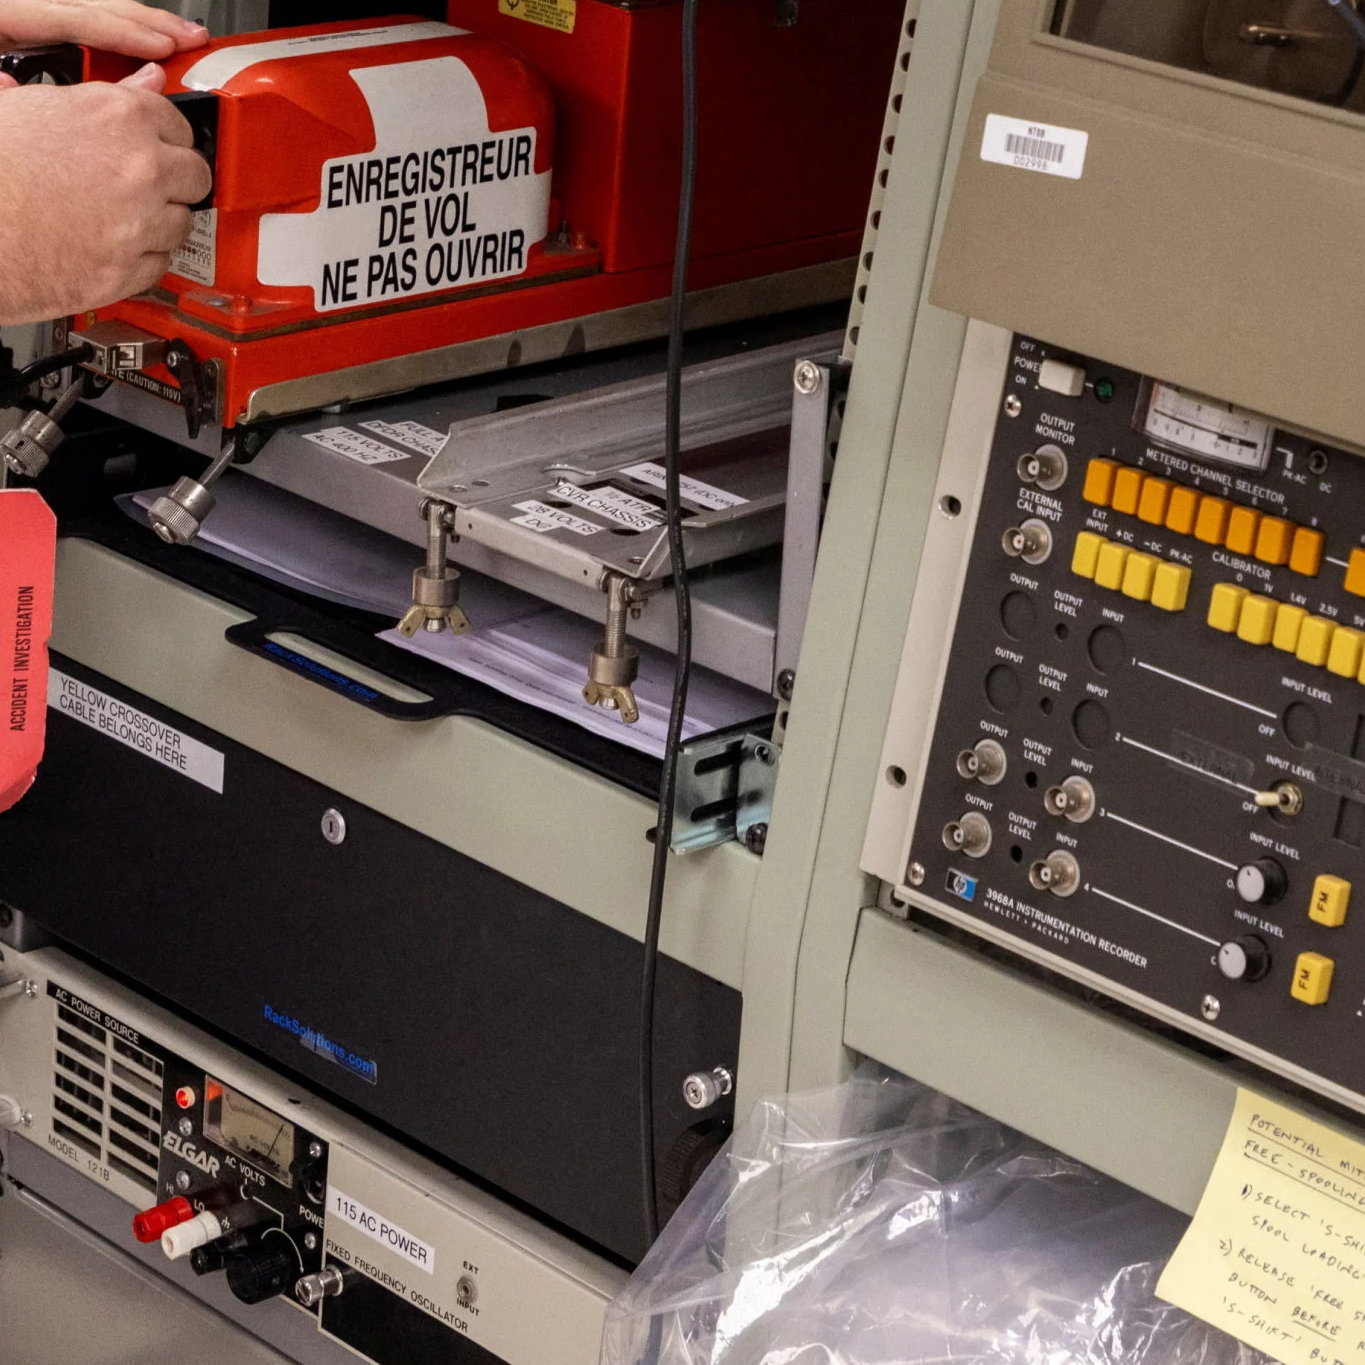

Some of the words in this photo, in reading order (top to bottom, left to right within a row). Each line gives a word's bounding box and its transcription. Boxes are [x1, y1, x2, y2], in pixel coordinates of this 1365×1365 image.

[327, 135, 532, 209] ENREGISTREUR
[378, 200, 417, 248] DE
[424, 191, 477, 240] VOL
[321, 257, 360, 307] NE
[366, 247, 417, 298] PAS
[424, 228, 526, 287] OUVRIR
[1035, 424, 1075, 446] MONITOR
[1040, 413, 1075, 432] OUTPUT
[1146, 448, 1189, 472] METERED
[1190, 462, 1233, 487] CHANNEL
[1235, 480, 1285, 504] SELECTOR
[557, 486, 587, 503] CVR
[587, 498, 654, 530] CHASSIS
[1017, 498, 1034, 513] CAL
[1035, 504, 1063, 523] INPUT
[1019, 488, 1063, 512] EXTERNAL
[1010, 573, 1039, 591] OUTPUT
[1211, 551, 1272, 581] CALIBRATOR
[14, 586, 34, 672] INVESTIGATION
[1102, 608, 1125, 623] INPUT
[11, 677, 29, 731] ACCIDENT
[60, 676, 107, 711] YELLOW
[109, 700, 182, 750] CROSSOVER
[59, 694, 96, 724] CABLE
[98, 712, 153, 756] BELONGS
[156, 742, 187, 771] HERE
[1250, 831, 1274, 851] INPUT
[1275, 843, 1300, 861] LEVEL
[984, 901, 1021, 924] HEWLETT
[1032, 922, 1070, 944] PACKARD
[986, 888, 1014, 909] 3968A
[1016, 902, 1097, 947] INSTRUMENTATION
[1098, 940, 1148, 968] RECORDER
[55, 989, 68, 1001] AC
[71, 995, 101, 1023] POWER
[104, 1016, 140, 1045] SOURCE
[263, 1004, 376, 1076] RackSolutions.com
[48, 1134, 79, 1162] MODEL
[87, 1160, 110, 1181] 121B
[162, 1129, 221, 1180] ELGAR
[1250, 1114, 1325, 1158] POTENTIAL
[224, 1155, 237, 1169] AC
[239, 1162, 266, 1187] VOLTS
[336, 1197, 357, 1220] 115
[359, 1215, 377, 1232] AC
[380, 1223, 428, 1264] POWER
[326, 1238, 351, 1261] FIXED
[355, 1256, 407, 1294] FREQUENCY
[410, 1291, 469, 1333] OSCILLATOR
[463, 1260, 479, 1275] EXT
[1228, 1272, 1278, 1305] BUTTON
[1238, 1247, 1296, 1287] RELEASE
[456, 1297, 480, 1317] INPUT
